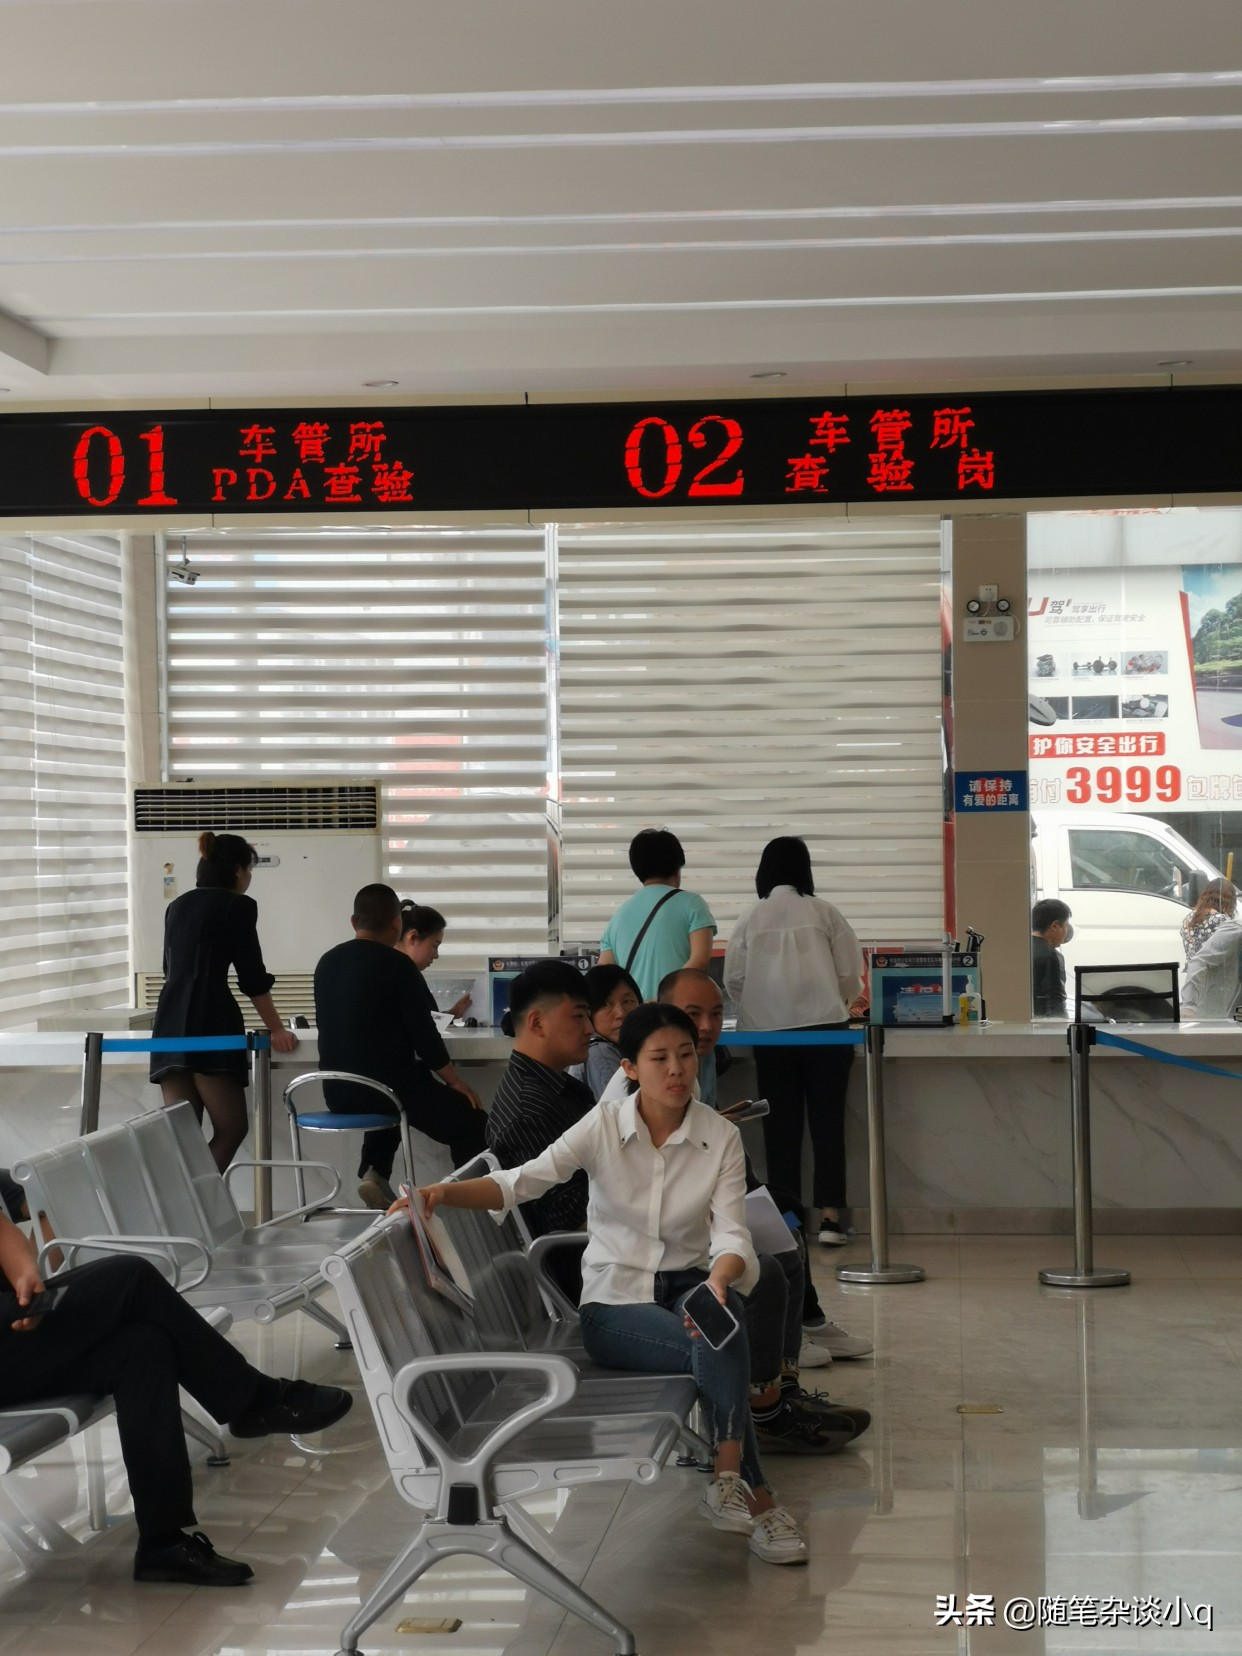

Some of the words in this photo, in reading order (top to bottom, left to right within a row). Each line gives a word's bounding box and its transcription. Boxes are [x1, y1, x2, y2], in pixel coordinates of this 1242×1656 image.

[239, 421, 388, 463] 车管所
[807, 407, 974, 450] 车管所
[74, 426, 178, 507] 01
[624, 415, 745, 498] 02
[785, 448, 994, 493] 查验岗
[211, 462, 414, 503] PDA查验
[1033, 735, 1159, 756] 护你安全出行
[962, 793, 1019, 807] 有爱的距离
[968, 779, 1013, 793] 请保持
[1066, 765, 1182, 804] 3999
